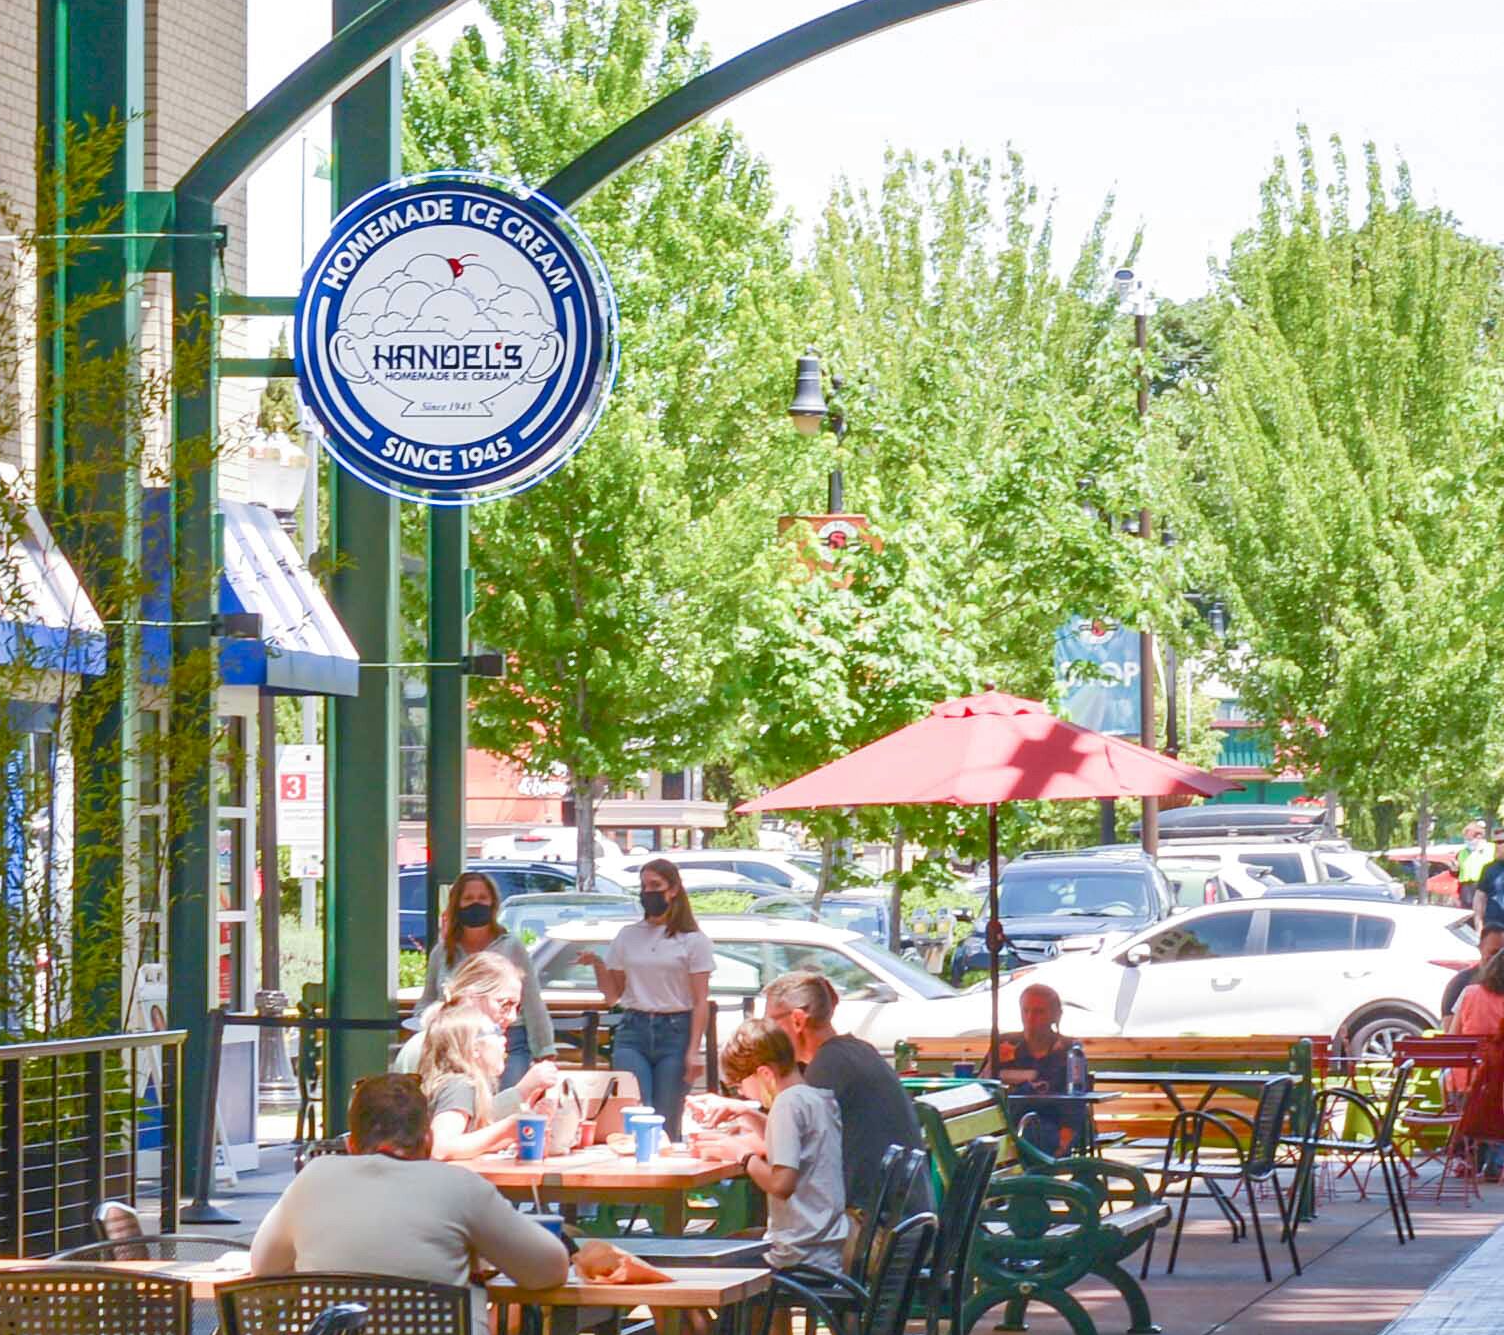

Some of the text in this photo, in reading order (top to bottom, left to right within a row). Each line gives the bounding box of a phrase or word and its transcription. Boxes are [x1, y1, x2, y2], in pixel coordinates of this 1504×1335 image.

[322, 198, 573, 295] HOMEMADE ICE CREAM
[373, 341, 523, 370] HANDEL'S
[385, 371, 510, 381] HOMEMADE ICE CREAM
[380, 436, 513, 471] SINCE 1945
[286, 776, 301, 799] 3
